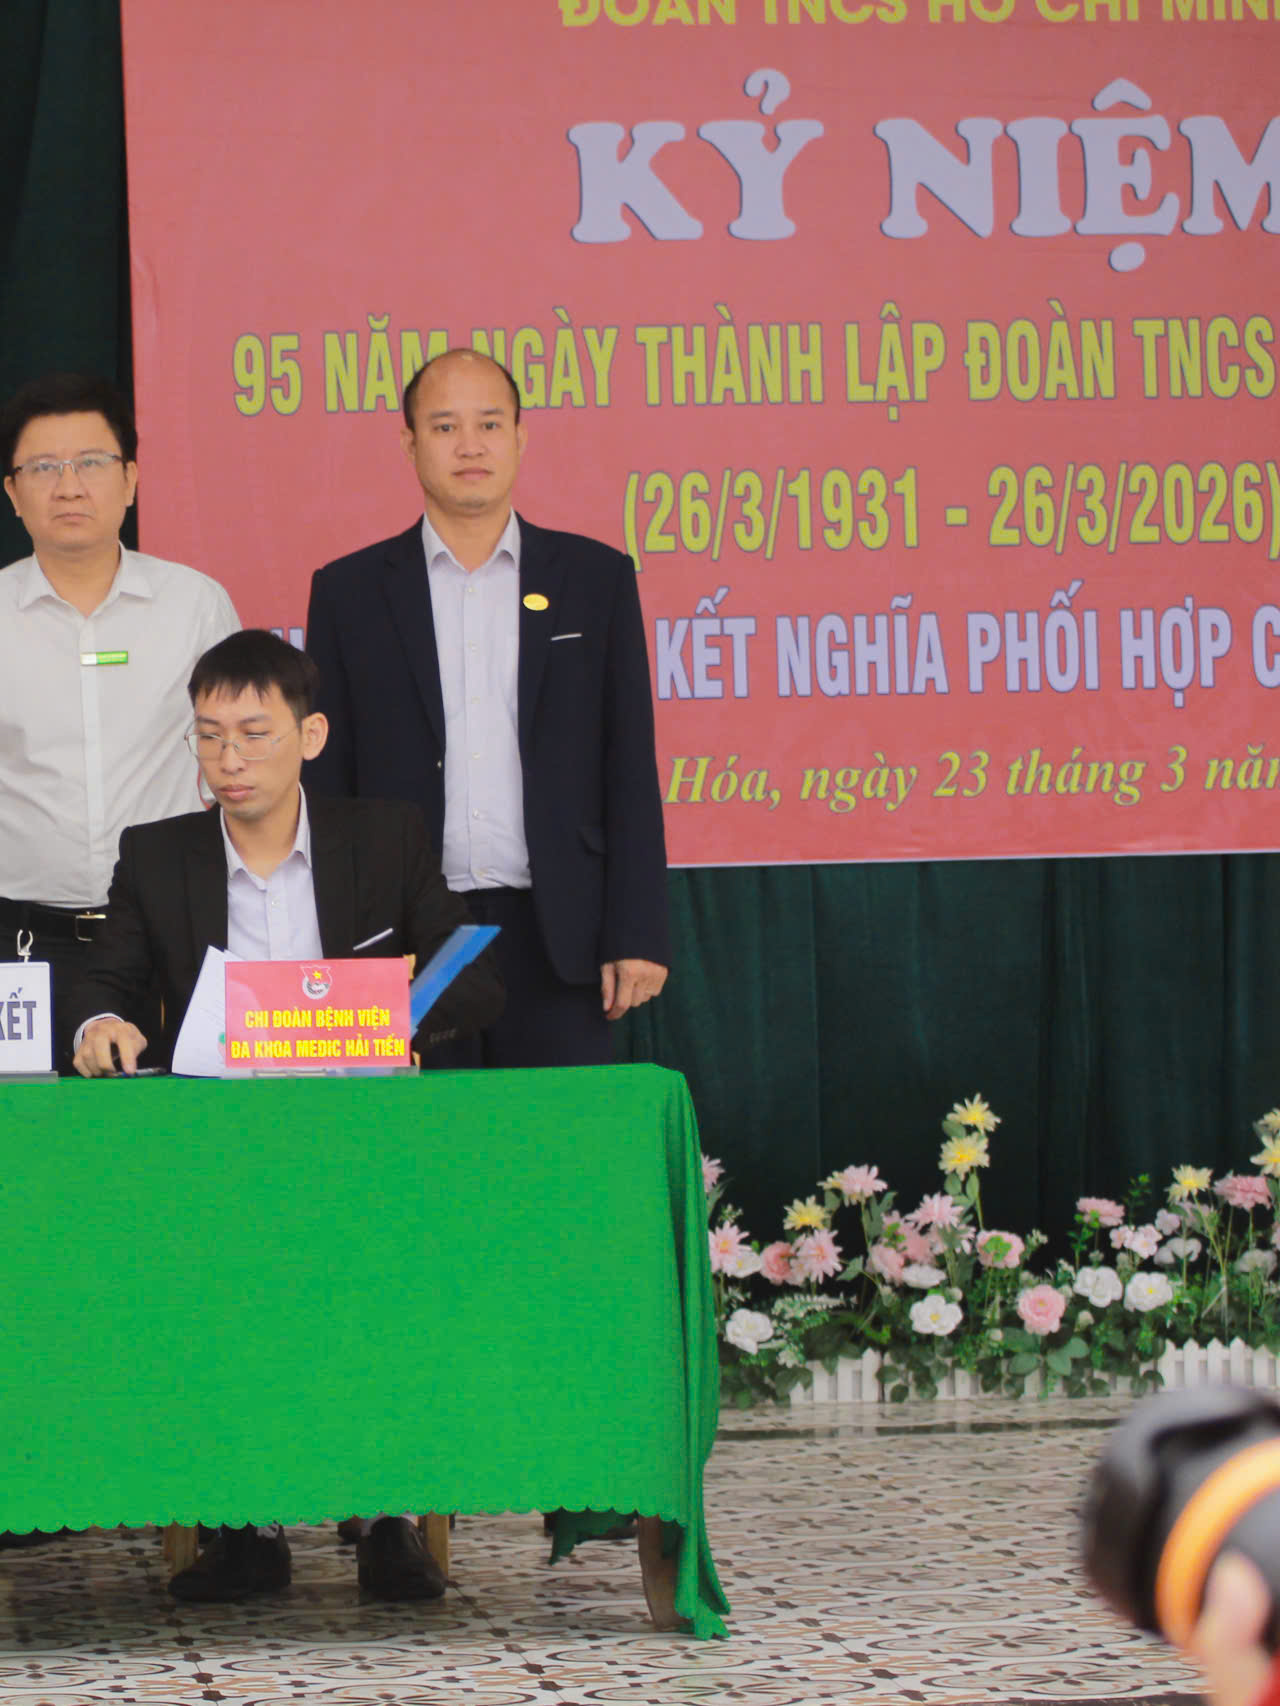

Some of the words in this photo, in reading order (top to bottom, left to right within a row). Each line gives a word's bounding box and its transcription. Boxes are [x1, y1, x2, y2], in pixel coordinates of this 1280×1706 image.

[1161, 0, 1280, 21] MIN
[568, 68, 826, 244] KỶ
[874, 78, 1280, 272] NIỆM
[232, 334, 303, 417] 95
[635, 303, 824, 407] THÀNH
[844, 302, 946, 422] LẬP
[962, 299, 1116, 402] ĐOÀN
[1132, 315, 1276, 399] TNCS
[623, 466, 919, 572] (26/3/1931
[987, 462, 1280, 560] 26/3/2026)
[654, 586, 757, 700] KẾT
[775, 594, 950, 698] NGHĨA
[966, 580, 1100, 693] PHỐI
[1119, 596, 1232, 708] HỢP
[662, 754, 782, 806] Hóa,
[798, 750, 919, 814] ngày
[932, 748, 991, 798] 23
[1005, 746, 1146, 807] tháng
[1159, 744, 1189, 793] 3
[1203, 744, 1280, 791] nă
[230, 1040, 252, 1059] ĐA
[253, 1039, 293, 1059] KHOA
[295, 1039, 342, 1058] MEDIC
[345, 1033, 370, 1057] HẢI
[372, 1032, 405, 1057] TIẾN
[243, 1009, 270, 1029] CHI
[271, 1005, 313, 1029] ĐOÀN
[315, 1005, 354, 1031] BỆNH
[356, 1004, 391, 1031] VIỆN
